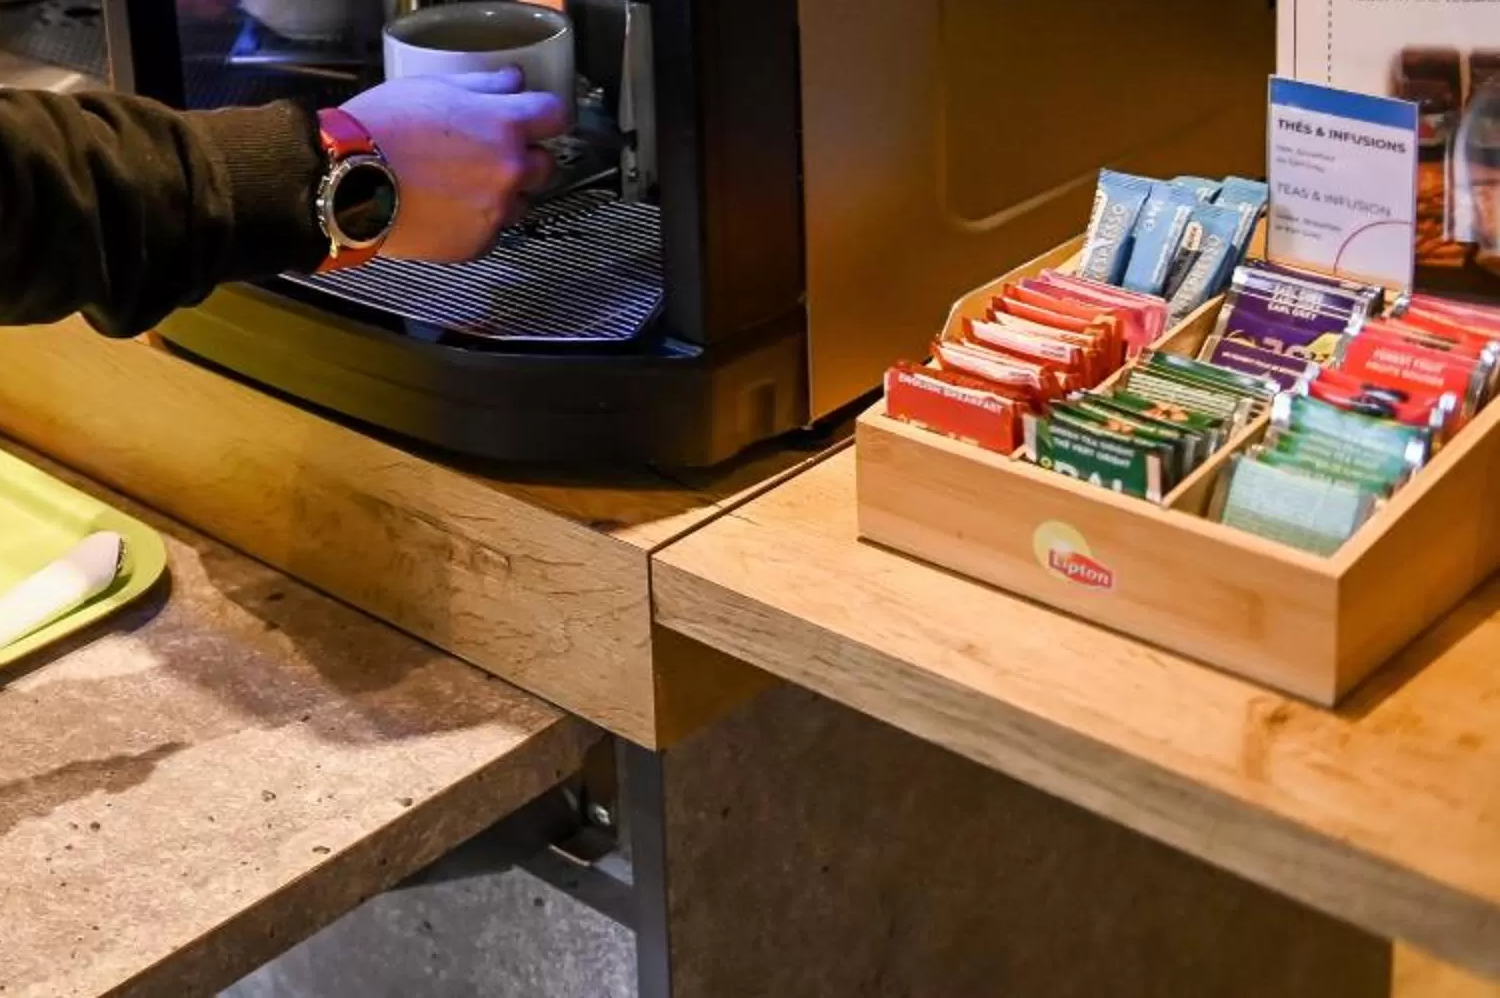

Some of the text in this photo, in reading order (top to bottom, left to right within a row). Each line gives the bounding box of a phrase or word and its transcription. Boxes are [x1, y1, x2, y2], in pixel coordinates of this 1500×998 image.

[1315, 127, 1326, 137] &
[1328, 129, 1407, 155] INFUSIONS
[1051, 549, 1110, 586] Lipton
